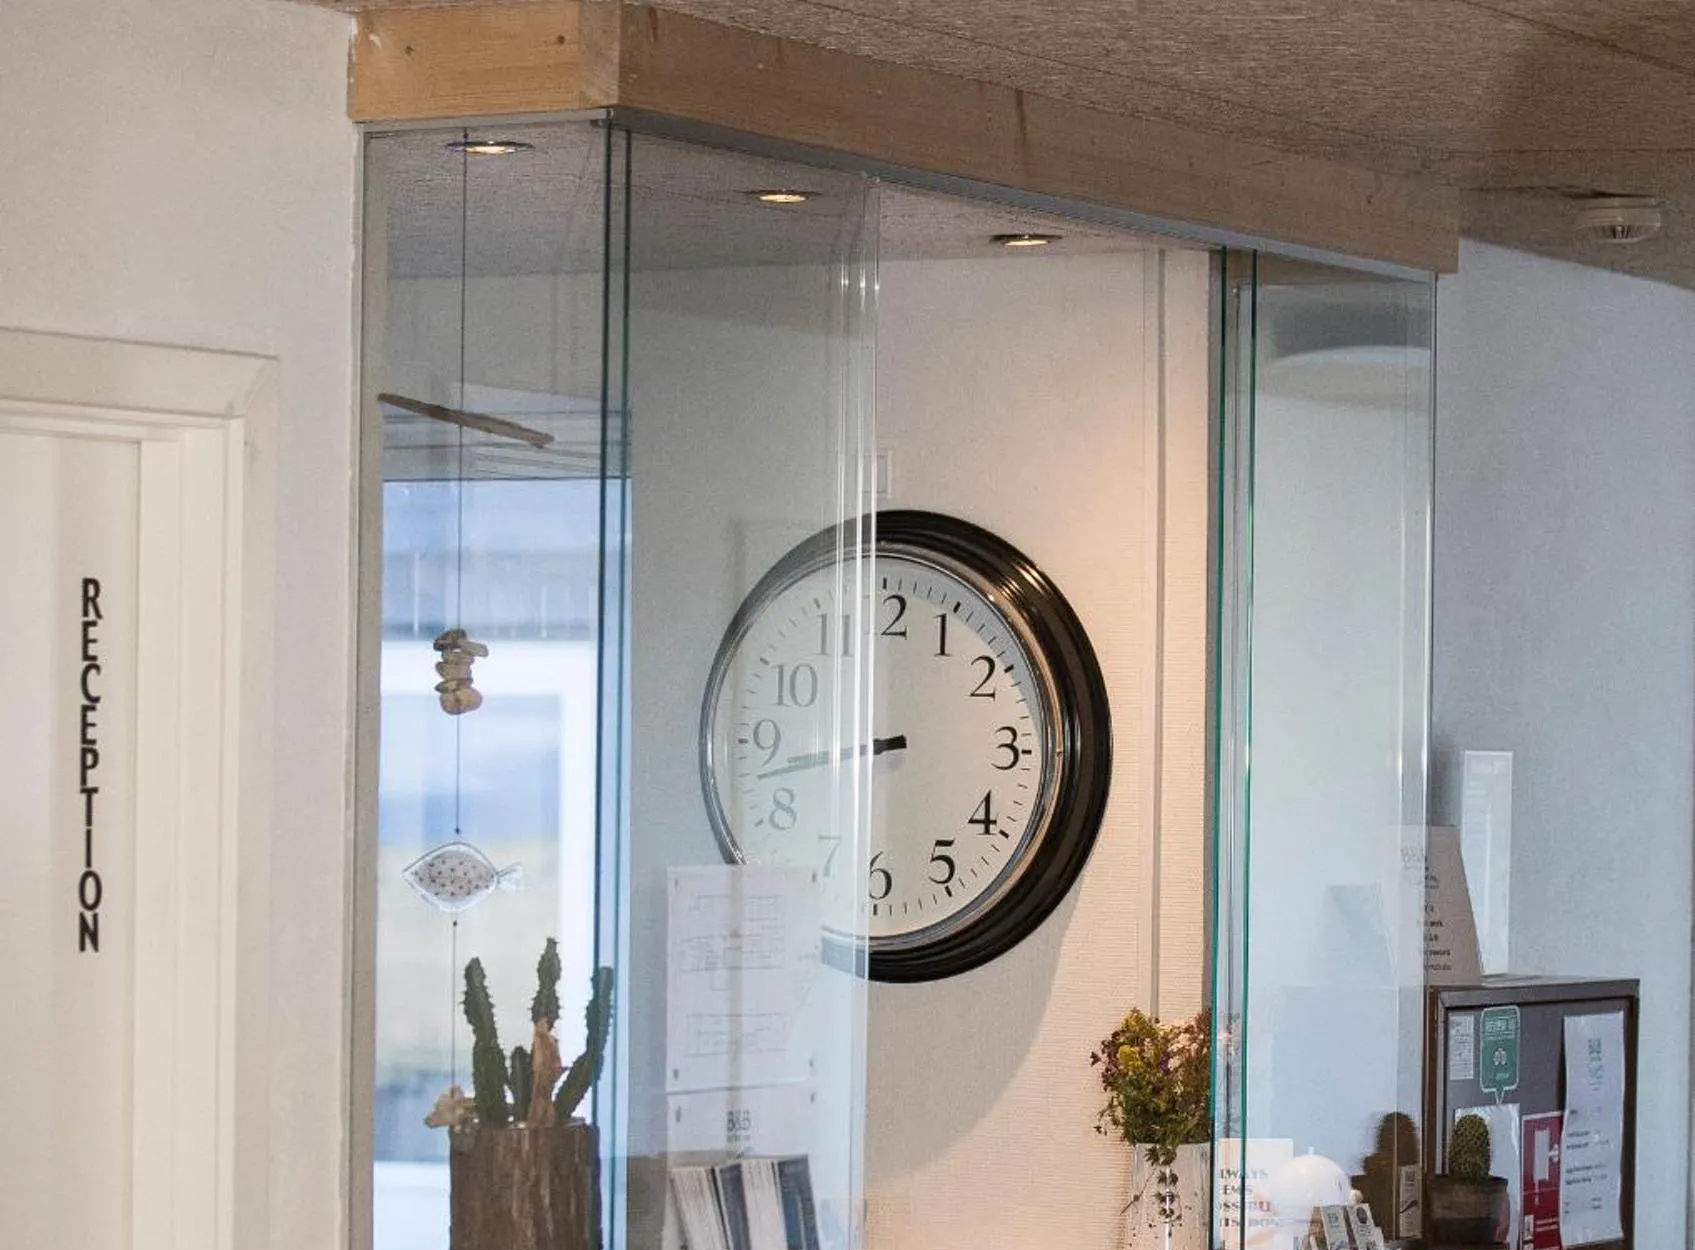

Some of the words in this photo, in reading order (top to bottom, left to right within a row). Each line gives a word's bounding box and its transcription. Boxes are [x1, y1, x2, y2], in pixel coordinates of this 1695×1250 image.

[815, 613, 856, 658] 11
[932, 612, 951, 657] 1
[772, 663, 819, 708] 10
[968, 655, 997, 701] 2
[78, 577, 104, 953] RECEPTION
[752, 718, 782, 767] 9
[993, 725, 1020, 771] 3
[768, 787, 798, 831] 8
[967, 790, 998, 836] 4
[818, 835, 842, 879] 7
[868, 850, 893, 900] 6
[929, 838, 957, 885] 5
